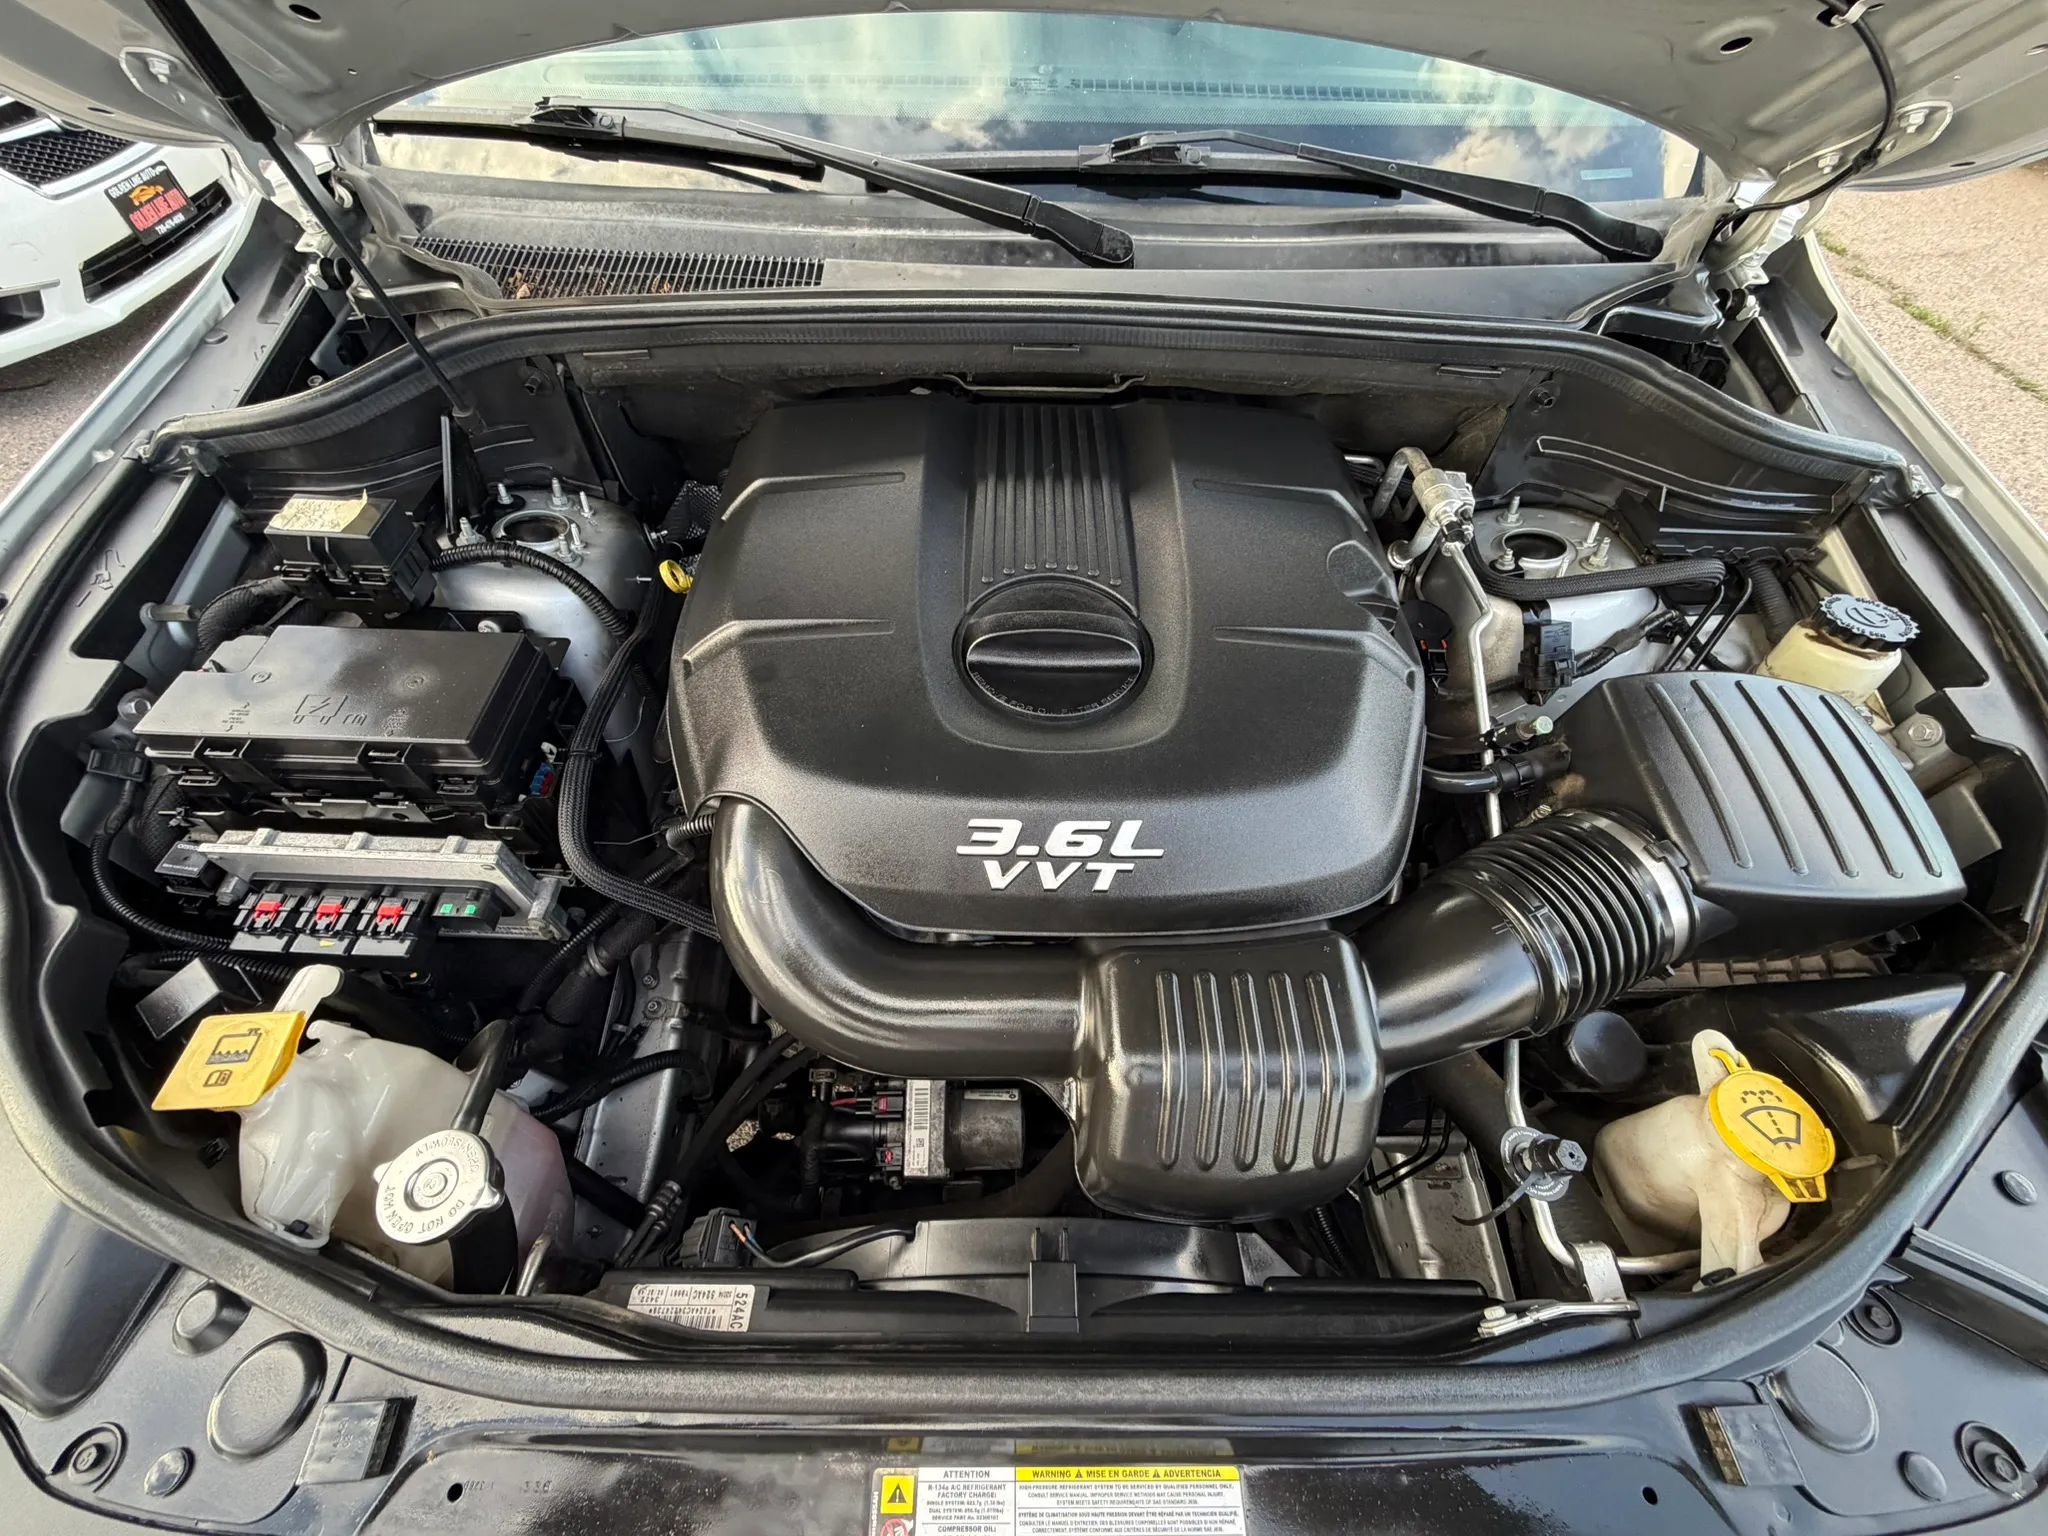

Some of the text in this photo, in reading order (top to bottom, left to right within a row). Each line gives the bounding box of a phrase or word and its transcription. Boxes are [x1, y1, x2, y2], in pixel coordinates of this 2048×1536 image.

[956, 818, 1165, 857] 3.6L
[983, 860, 1135, 892] VVT
[448, 1200, 465, 1217] DO
[386, 1210, 414, 1234] OPEN
[417, 1216, 444, 1234] NOT
[730, 1292, 748, 1329] 524AC
[943, 1470, 990, 1478] ATTENTION
[1032, 1469, 1221, 1478] WARNING MISE EN GARDE ADVERTENCIA
